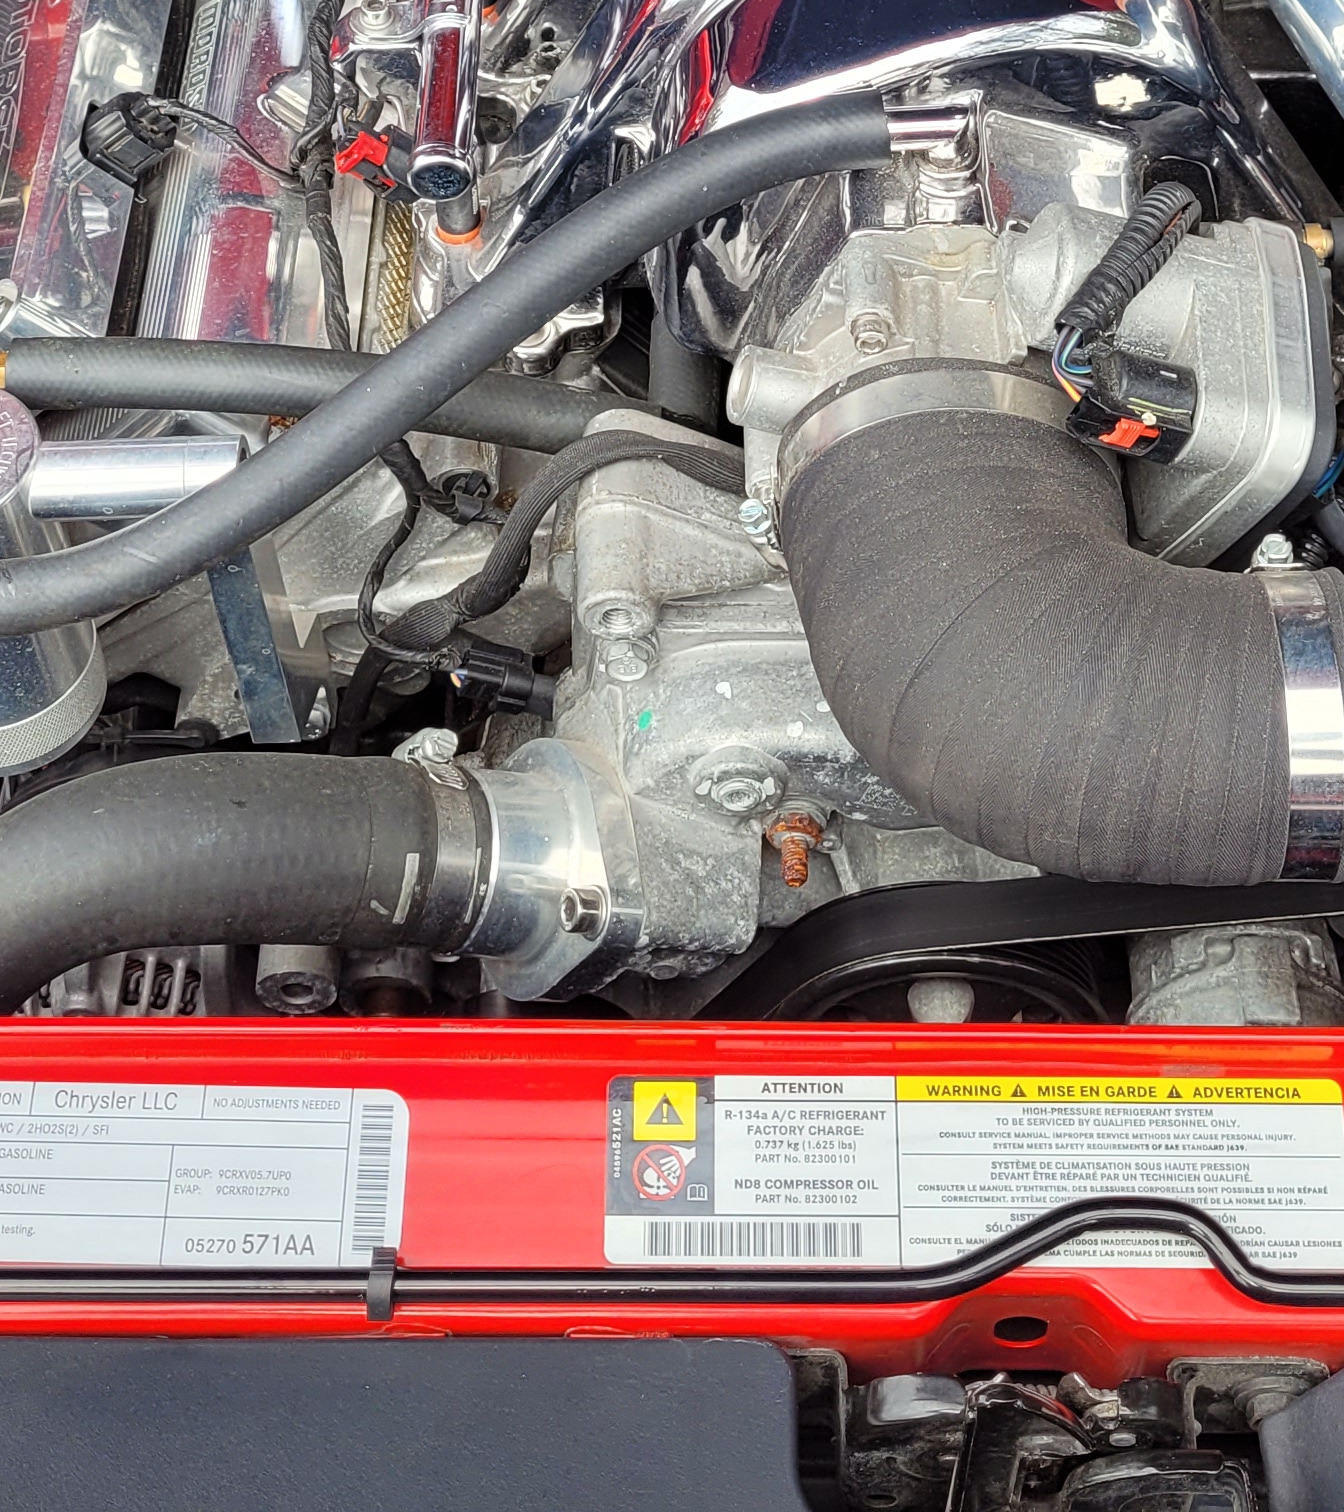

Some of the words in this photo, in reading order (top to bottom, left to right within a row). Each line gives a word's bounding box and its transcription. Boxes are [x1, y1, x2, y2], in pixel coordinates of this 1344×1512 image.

[761, 1082, 843, 1094] ATTENTION
[925, 1084, 1001, 1097] WARNING
[1037, 1085, 1075, 1097] MISE
[1079, 1085, 1100, 1097] EN
[1104, 1085, 1157, 1098] GARDE
[1192, 1086, 1301, 1099] ADVERTENCIA
[54, 1089, 136, 1114] Chrysler
[141, 1090, 178, 1110] LLC
[212, 1097, 228, 1108] NO
[229, 1097, 299, 1109] ADJUSTMENTS
[301, 1099, 341, 1110] NEEDED
[724, 1109, 768, 1120] R-134a
[771, 1109, 796, 1121] A/C
[799, 1109, 887, 1120] REFRIGERANT
[1022, 1106, 1102, 1116] HIGH-PRESSURE
[1104, 1107, 1172, 1116] REFRIGERANT
[1174, 1108, 1213, 1117] SYSTEM
[995, 1117, 1009, 1126] TO
[1011, 1117, 1024, 1126] BE
[1026, 1117, 1075, 1126] SERVICED
[1077, 1117, 1090, 1126] BY
[1092, 1118, 1146, 1127] QUALIFIED
[1148, 1118, 1208, 1127] PERSONNEL
[1210, 1119, 1240, 1128] ONLY.
[26, 1122, 79, 1137] 2HO2S(2)
[92, 1124, 109, 1136] SFI
[746, 1124, 805, 1136] FACTORY
[808, 1124, 864, 1136] CHARGE:
[978, 1131, 1012, 1139] SERVICE
[1052, 1131, 1094, 1139] IMPROPER
[1096, 1132, 1130, 1140] SERVICE
[1131, 1132, 1171, 1140] METHODS
[1220, 1133, 1263, 1141] PERSONAL
[1264, 1133, 1296, 1142] INJURY.
[754, 1139, 784, 1149] 0.737
[786, 1139, 799, 1152] kg
[802, 1139, 835, 1152] (1.625
[837, 1139, 856, 1152] lbs)
[1054, 1142, 1084, 1150] SAFETY
[1164, 1143, 1179, 1151] SAE
[1181, 1143, 1224, 1151] STANDARD
[754, 1153, 781, 1163] PART
[783, 1153, 801, 1163] No.
[803, 1153, 855, 1164] 82300101
[1039, 1161, 1053, 1170] DE
[1054, 1161, 1131, 1170] CLIMATISATION
[1134, 1161, 1162, 1171] SOUS
[1164, 1162, 1198, 1171] HAUTE
[1200, 1162, 1250, 1171] PRESSION
[174, 1167, 212, 1179] GROUP:
[990, 1171, 1030, 1180] DEVANT
[1100, 1172, 1120, 1181] PAR
[1122, 1172, 1137, 1181] UN
[1139, 1172, 1200, 1182] TECHNICIEN
[173, 1184, 201, 1195] EVAP:
[734, 1178, 761, 1189] ND8
[764, 1178, 853, 1190] COMPRESSOR
[856, 1179, 879, 1190] OIL
[755, 1194, 781, 1203] PART
[784, 1194, 801, 1204] No.
[804, 1194, 857, 1204] 82300102
[0, 1223, 36, 1237] testing.
[184, 1238, 237, 1254] 05270
[241, 1233, 316, 1256] 571AA
